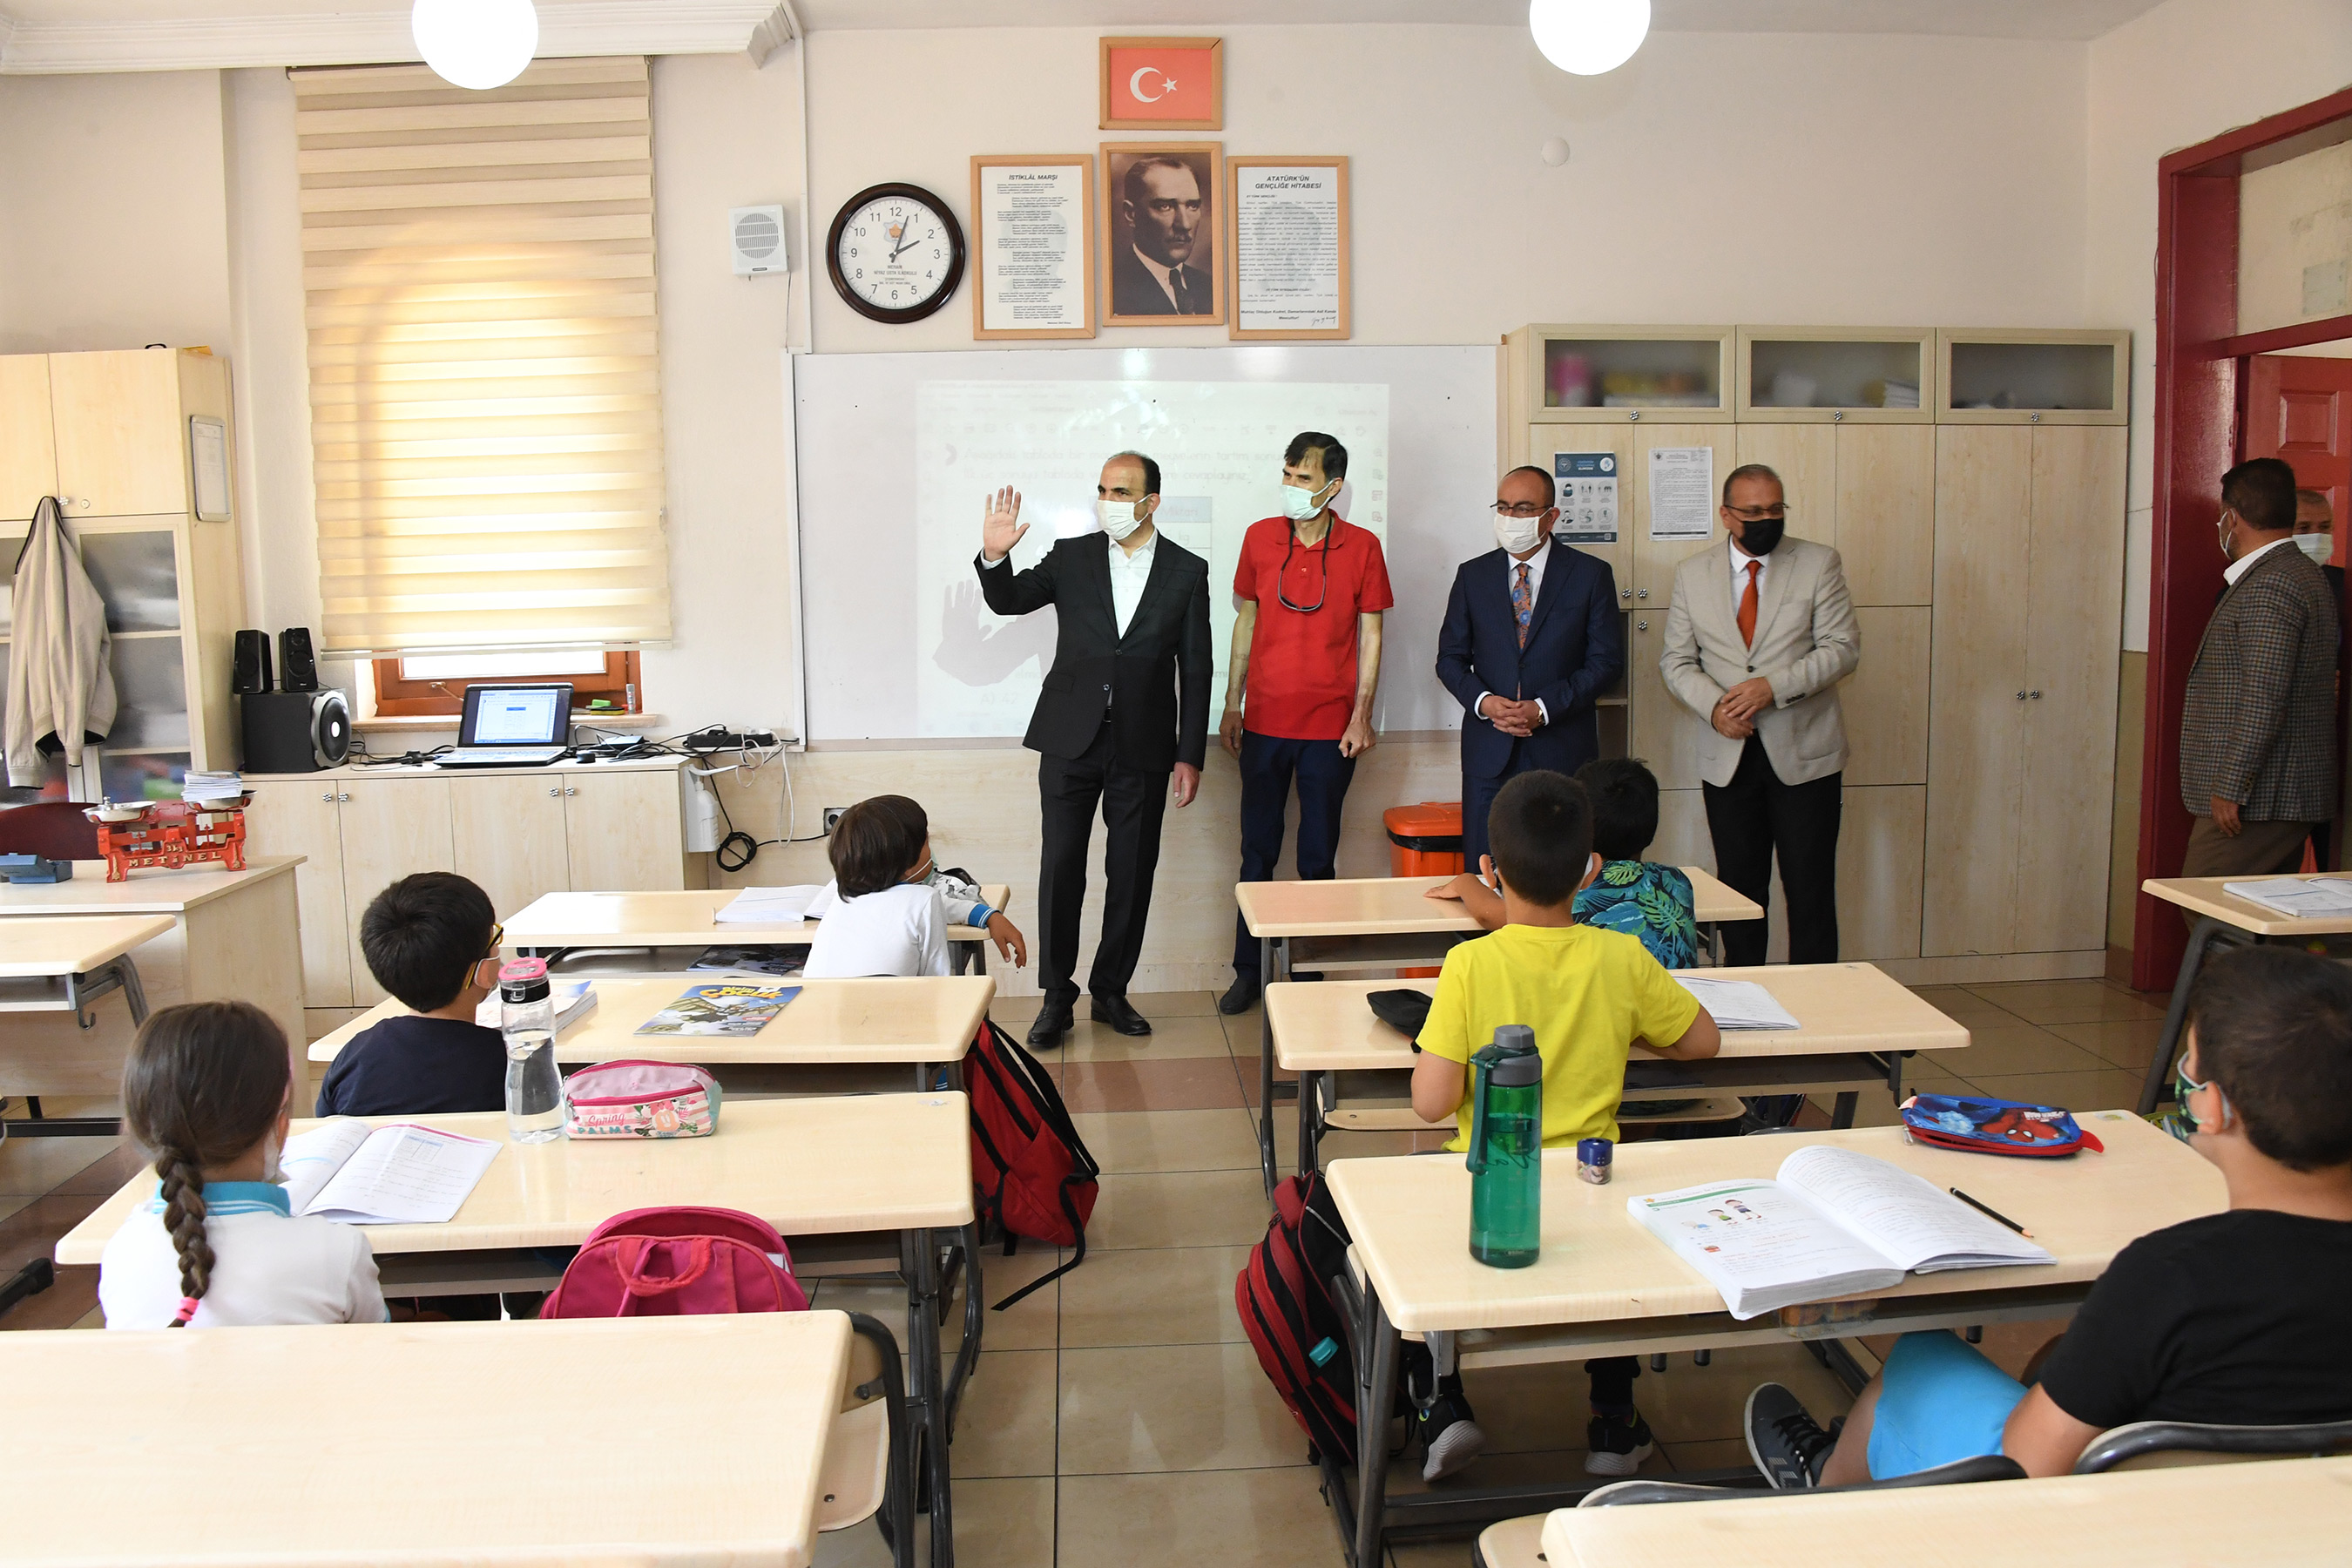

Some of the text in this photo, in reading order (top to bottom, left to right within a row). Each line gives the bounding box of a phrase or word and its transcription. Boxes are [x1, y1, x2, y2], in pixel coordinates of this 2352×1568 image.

[889, 206, 902, 217] 12
[869, 213, 881, 222] 11
[914, 213, 919, 223] 1
[854, 227, 867, 237] 10
[927, 229, 935, 240] 2
[850, 247, 858, 258] 9
[933, 249, 941, 260] 3
[855, 268, 863, 279] 8
[925, 270, 933, 280] 4
[871, 284, 878, 294] 7
[910, 286, 917, 295] 5
[891, 290, 898, 301] 6
[588, 1113, 626, 1127] Spring
[577, 1125, 632, 1134] PALMS
